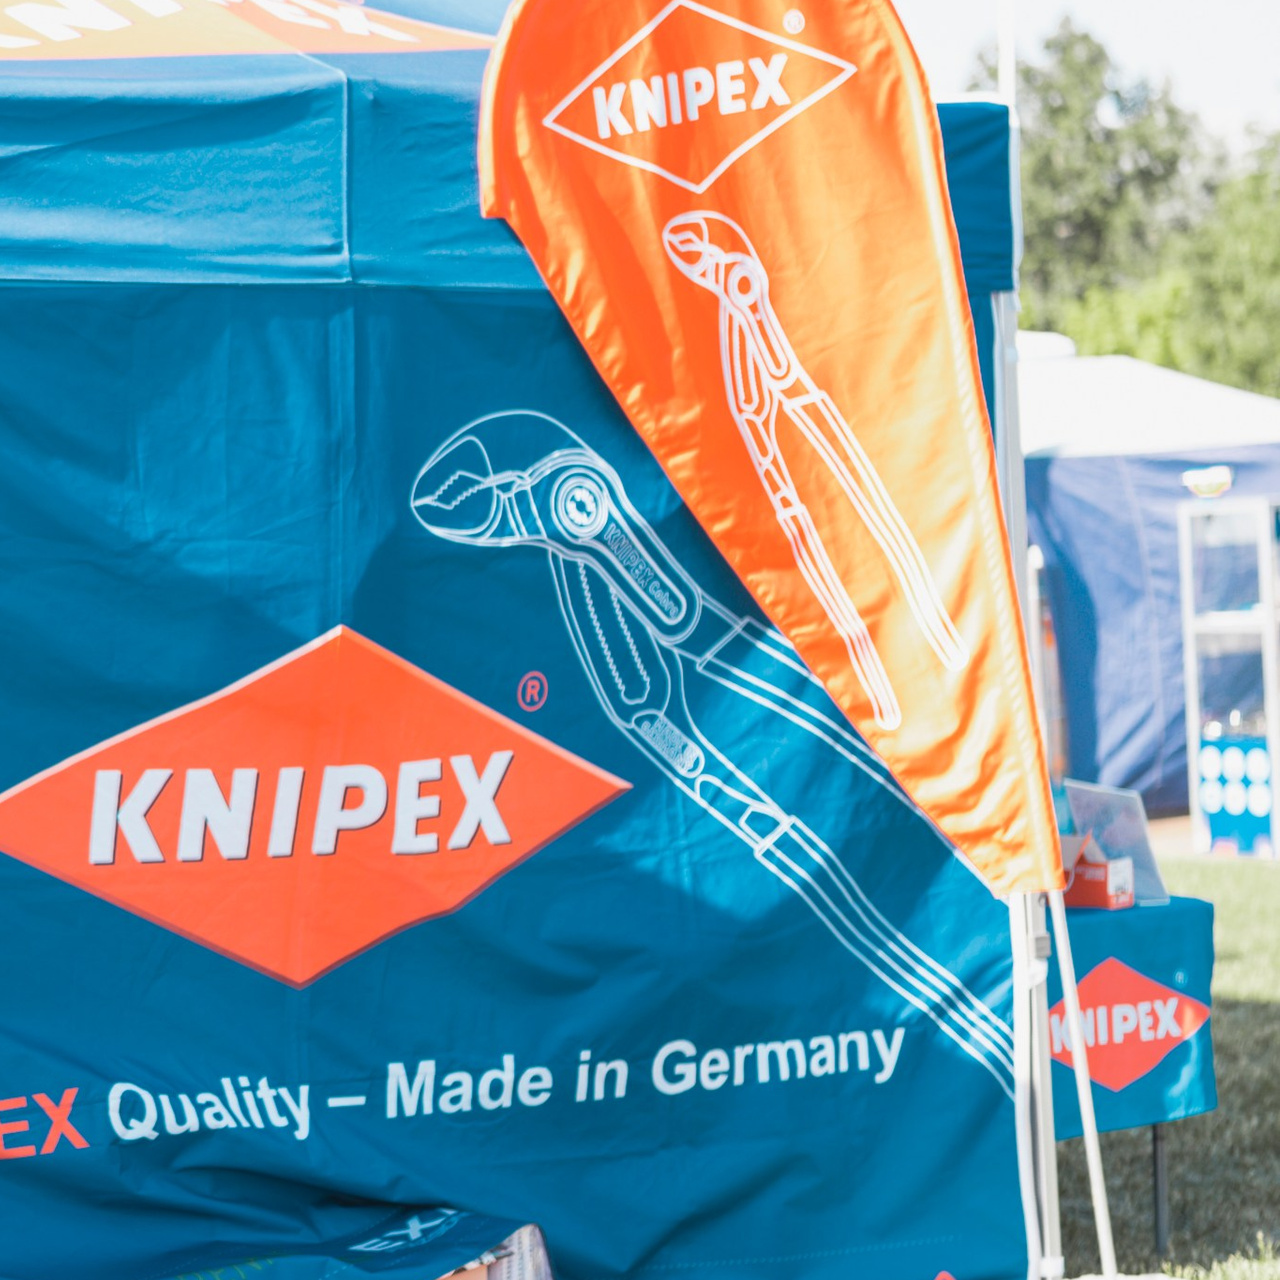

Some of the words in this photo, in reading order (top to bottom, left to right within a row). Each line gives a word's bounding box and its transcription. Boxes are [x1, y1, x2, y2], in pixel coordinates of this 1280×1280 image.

[592, 52, 791, 139] KNIPEX
[603, 522, 655, 589] KNIPEX
[88, 749, 514, 866] KNIPEX
[108, 1076, 311, 1141] Quality
[385, 1054, 554, 1119] Made
[575, 1051, 629, 1103] in
[651, 1026, 905, 1099] Germany
